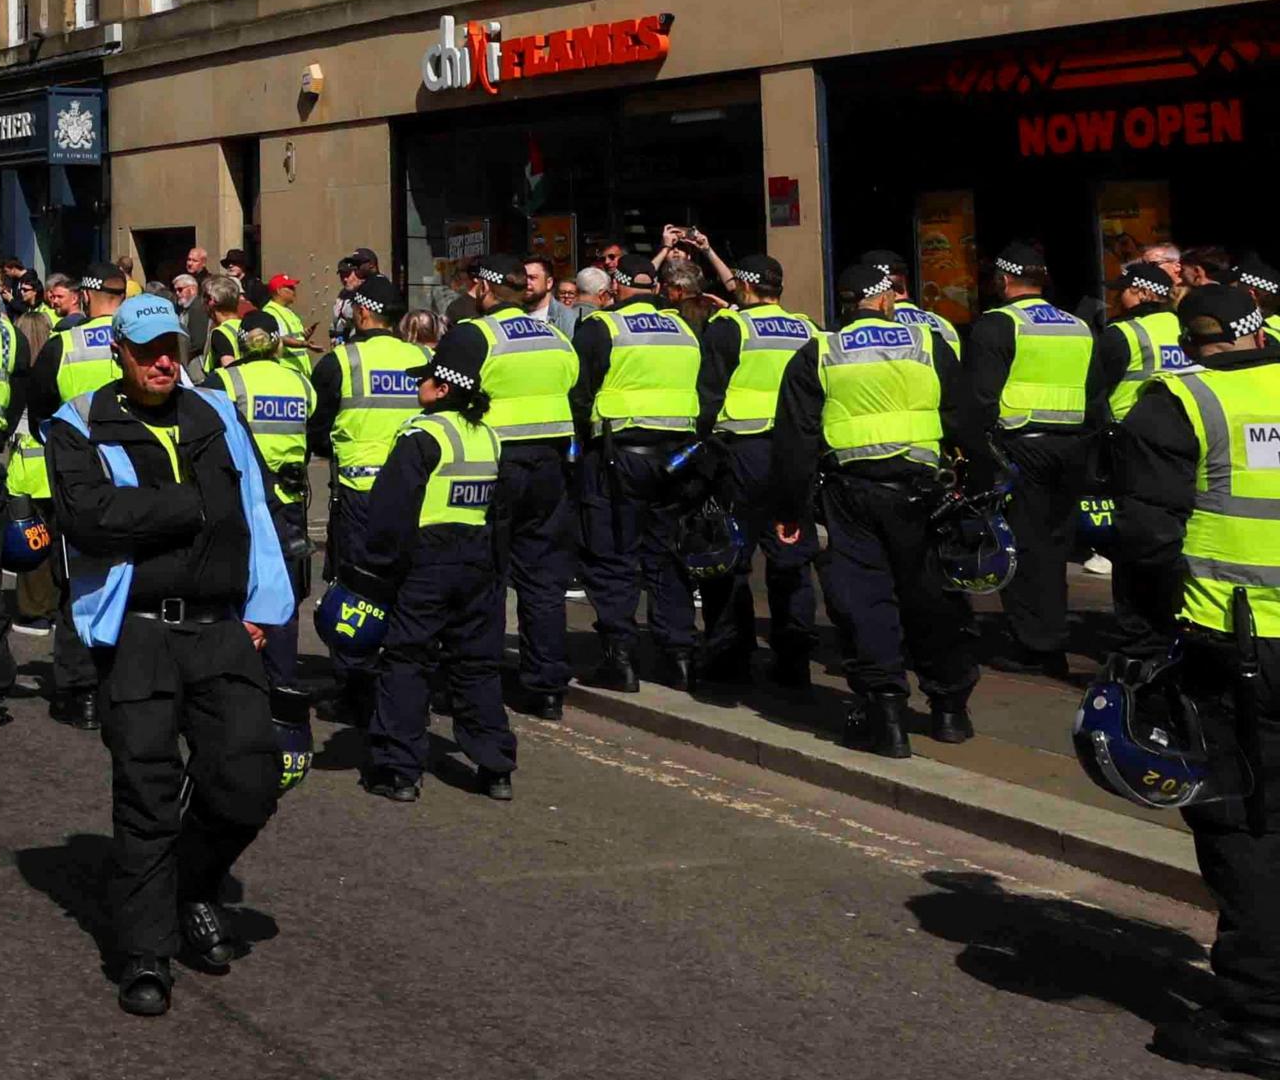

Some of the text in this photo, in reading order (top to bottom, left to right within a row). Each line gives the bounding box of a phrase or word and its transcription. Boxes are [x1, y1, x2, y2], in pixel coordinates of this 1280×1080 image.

[500, 14, 670, 81] FLAMES
[1016, 95, 1246, 158] NOW OPEN
[136, 305, 171, 319] POLICE
[627, 316, 676, 331] POLICE
[756, 319, 808, 336] POLICE
[84, 328, 113, 346] POL
[842, 330, 911, 348] POLICE
[1161, 350, 1194, 366] POL
[371, 373, 422, 392] POLIC
[255, 398, 306, 419] POLICE
[452, 484, 497, 503] POLIC
[1090, 511, 1113, 527] LA
[341, 602, 368, 628] LA
